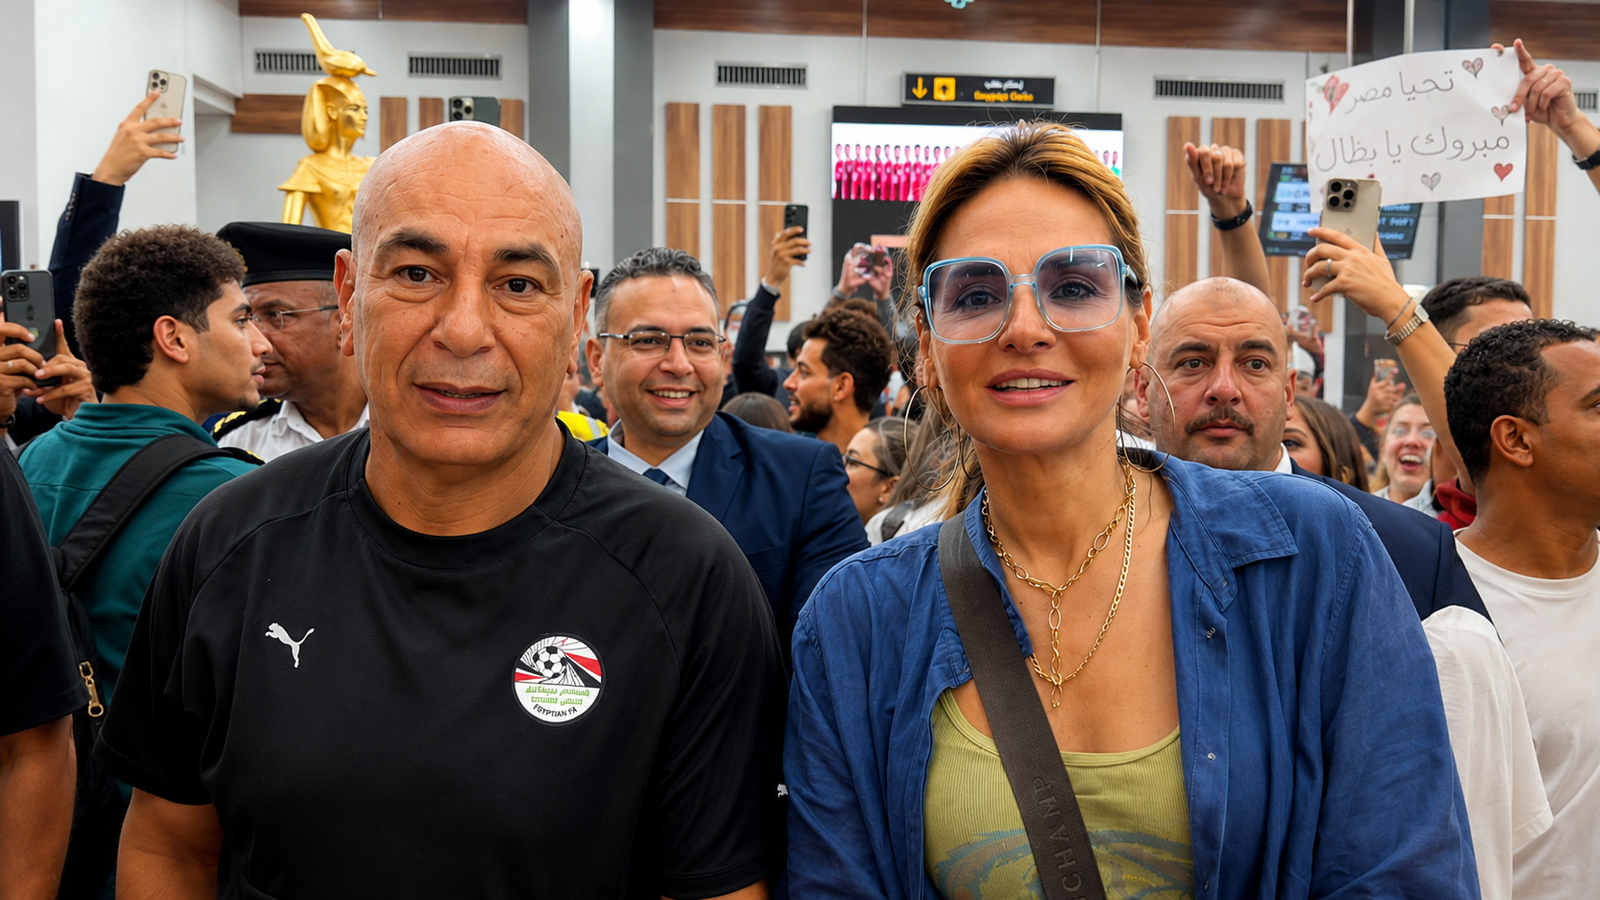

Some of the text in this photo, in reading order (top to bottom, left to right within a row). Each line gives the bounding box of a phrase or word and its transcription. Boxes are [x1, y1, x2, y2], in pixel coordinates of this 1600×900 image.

[1344, 70, 1454, 115] تحيا مصر
[1385, 129, 1402, 164] يا
[1410, 125, 1510, 162] مبروك
[533, 703, 578, 717] EGYPTIAN FA
[1032, 777, 1087, 900] CHAMP
